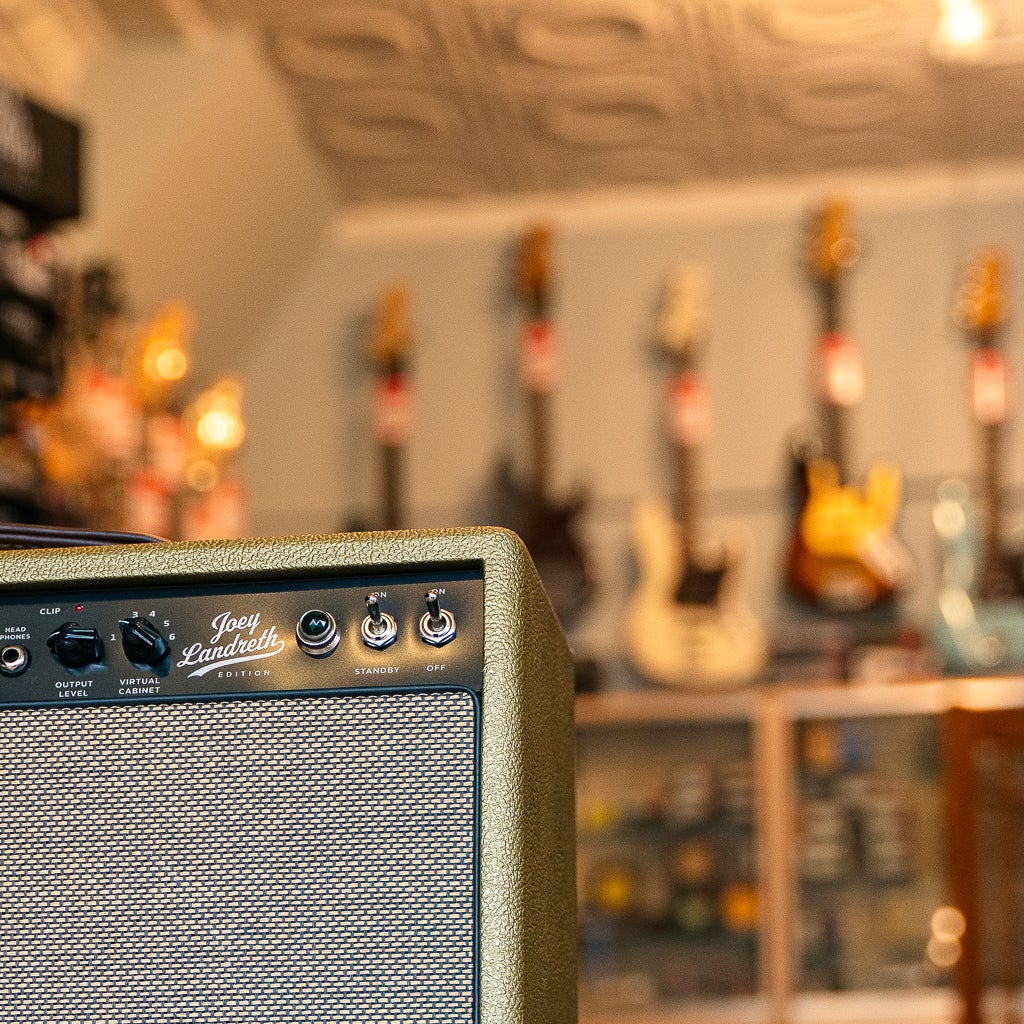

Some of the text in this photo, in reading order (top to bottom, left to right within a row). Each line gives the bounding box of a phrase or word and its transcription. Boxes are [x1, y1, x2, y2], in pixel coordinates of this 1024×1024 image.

[211, 611, 260, 643] Joey
[176, 626, 284, 668] Landreth
[354, 667, 400, 676] STANDBY
[426, 664, 446, 672] OFF
[218, 670, 270, 678] EDITION
[55, 680, 94, 688] OUTPUT
[120, 677, 161, 686] VIRTUAL
[118, 686, 161, 695] CABINET
